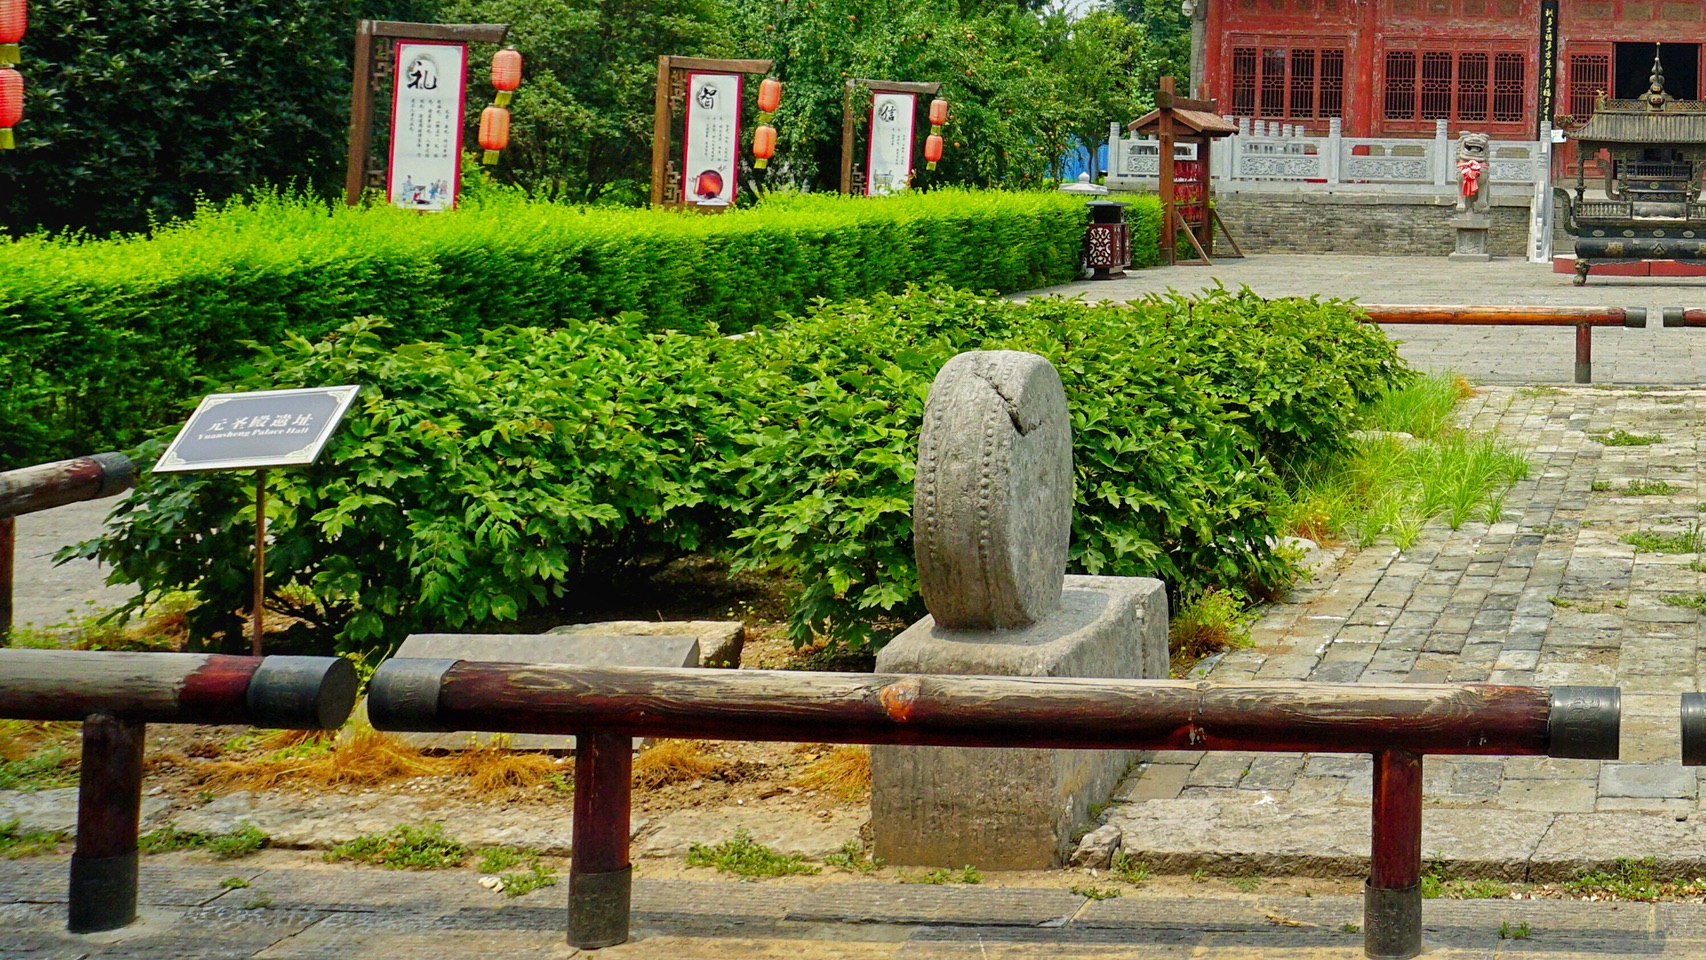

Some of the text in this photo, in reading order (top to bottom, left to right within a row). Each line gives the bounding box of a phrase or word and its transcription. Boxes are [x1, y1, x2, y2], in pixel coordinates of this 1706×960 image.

[407, 61, 437, 91] 礼
[881, 105, 897, 122] 信
[206, 413, 313, 432] 元圣殿遗址
[252, 428, 285, 437] Palace
[286, 426, 309, 435] Hall
